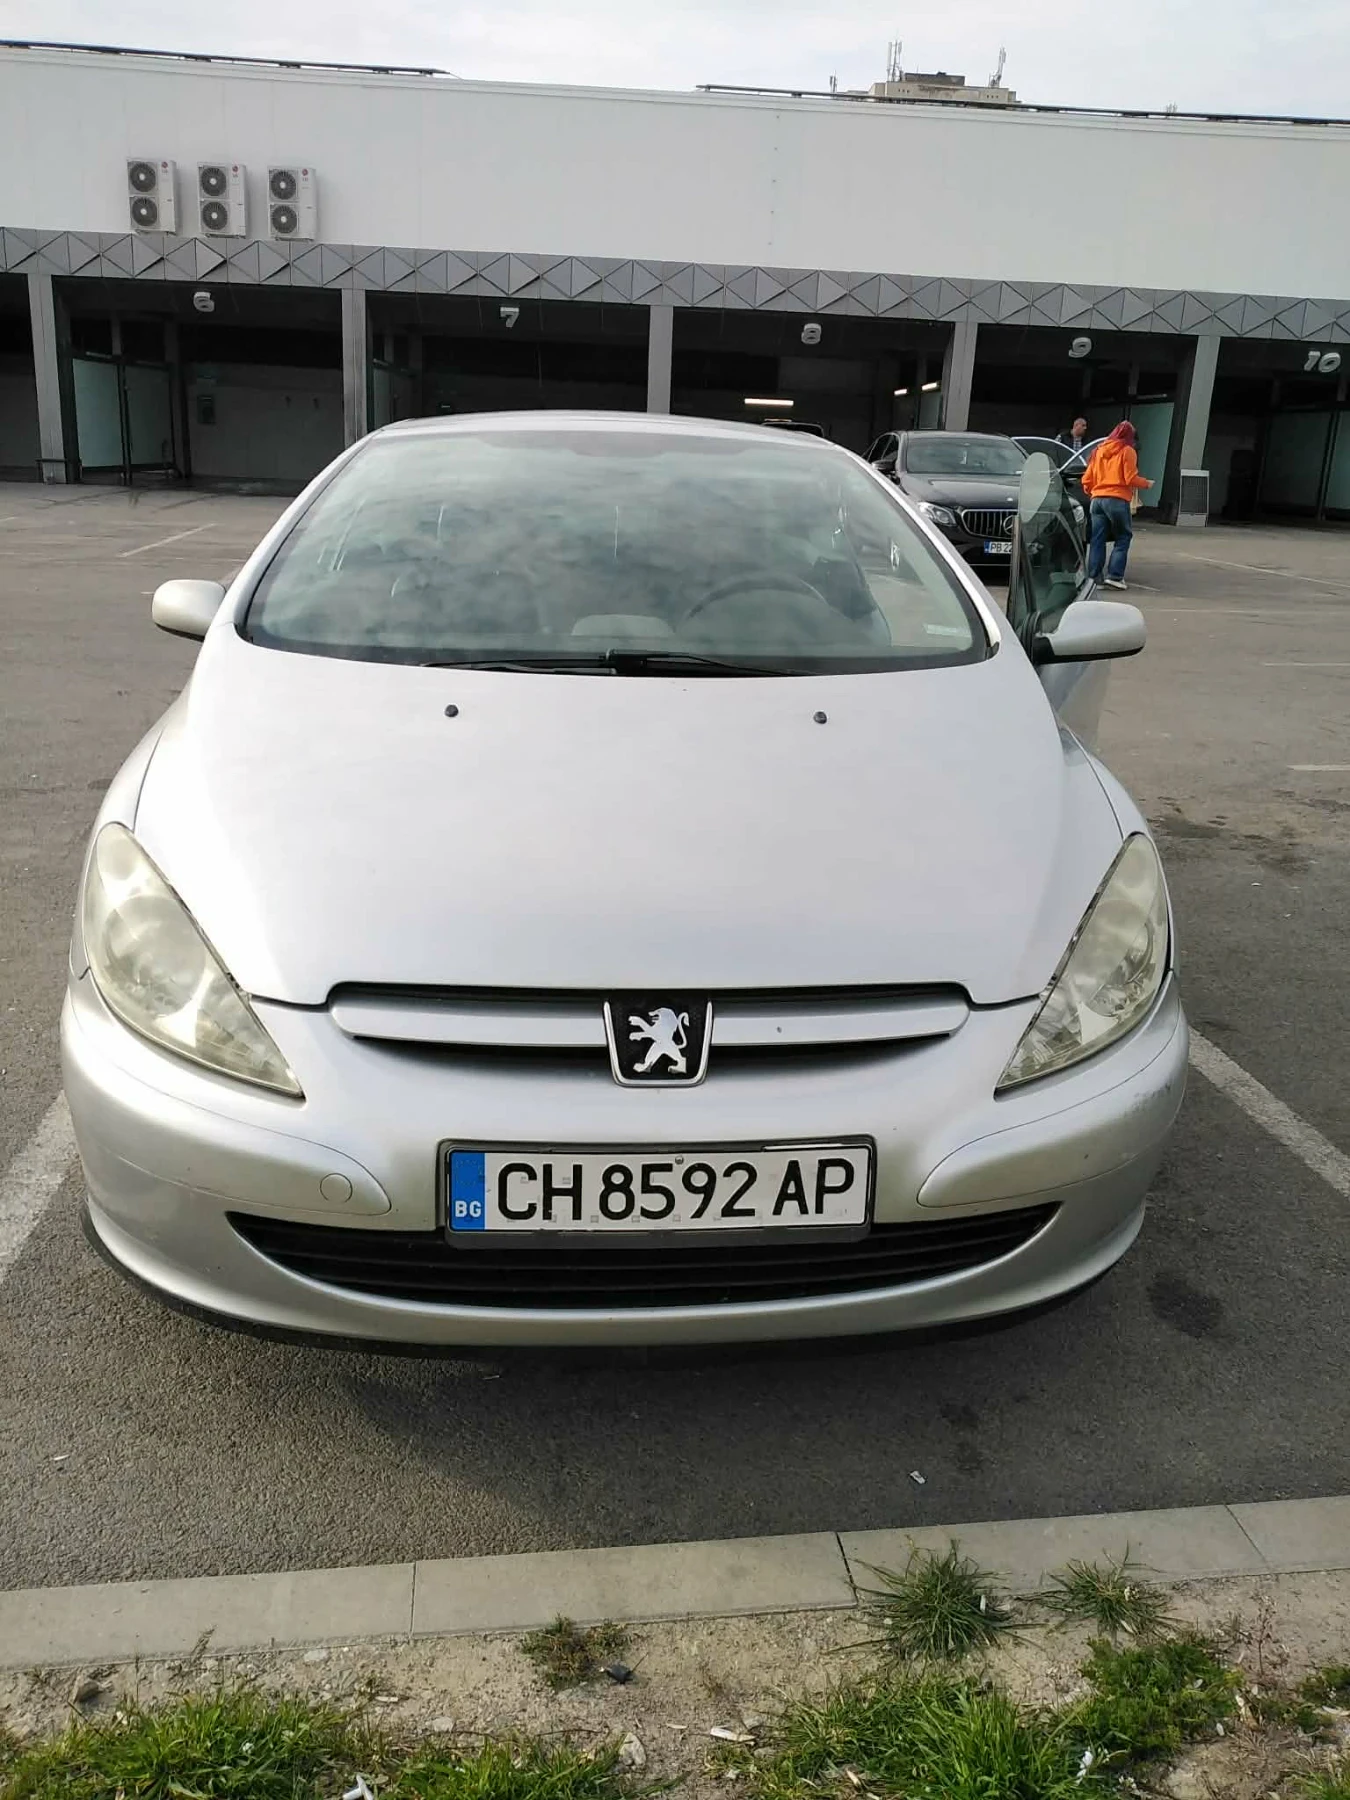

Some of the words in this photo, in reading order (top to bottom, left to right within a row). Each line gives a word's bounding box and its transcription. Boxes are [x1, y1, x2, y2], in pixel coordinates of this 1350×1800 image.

[193, 291, 215, 312] 6
[500, 306, 520, 327] 7
[801, 323, 822, 344] 8
[1068, 336, 1092, 358] 9
[1303, 350, 1341, 373] 10
[990, 543, 1002, 553] PB
[498, 1162, 582, 1220] CH
[599, 1161, 758, 1220] 8592
[772, 1158, 855, 1216] AP
[455, 1200, 482, 1218] BG
